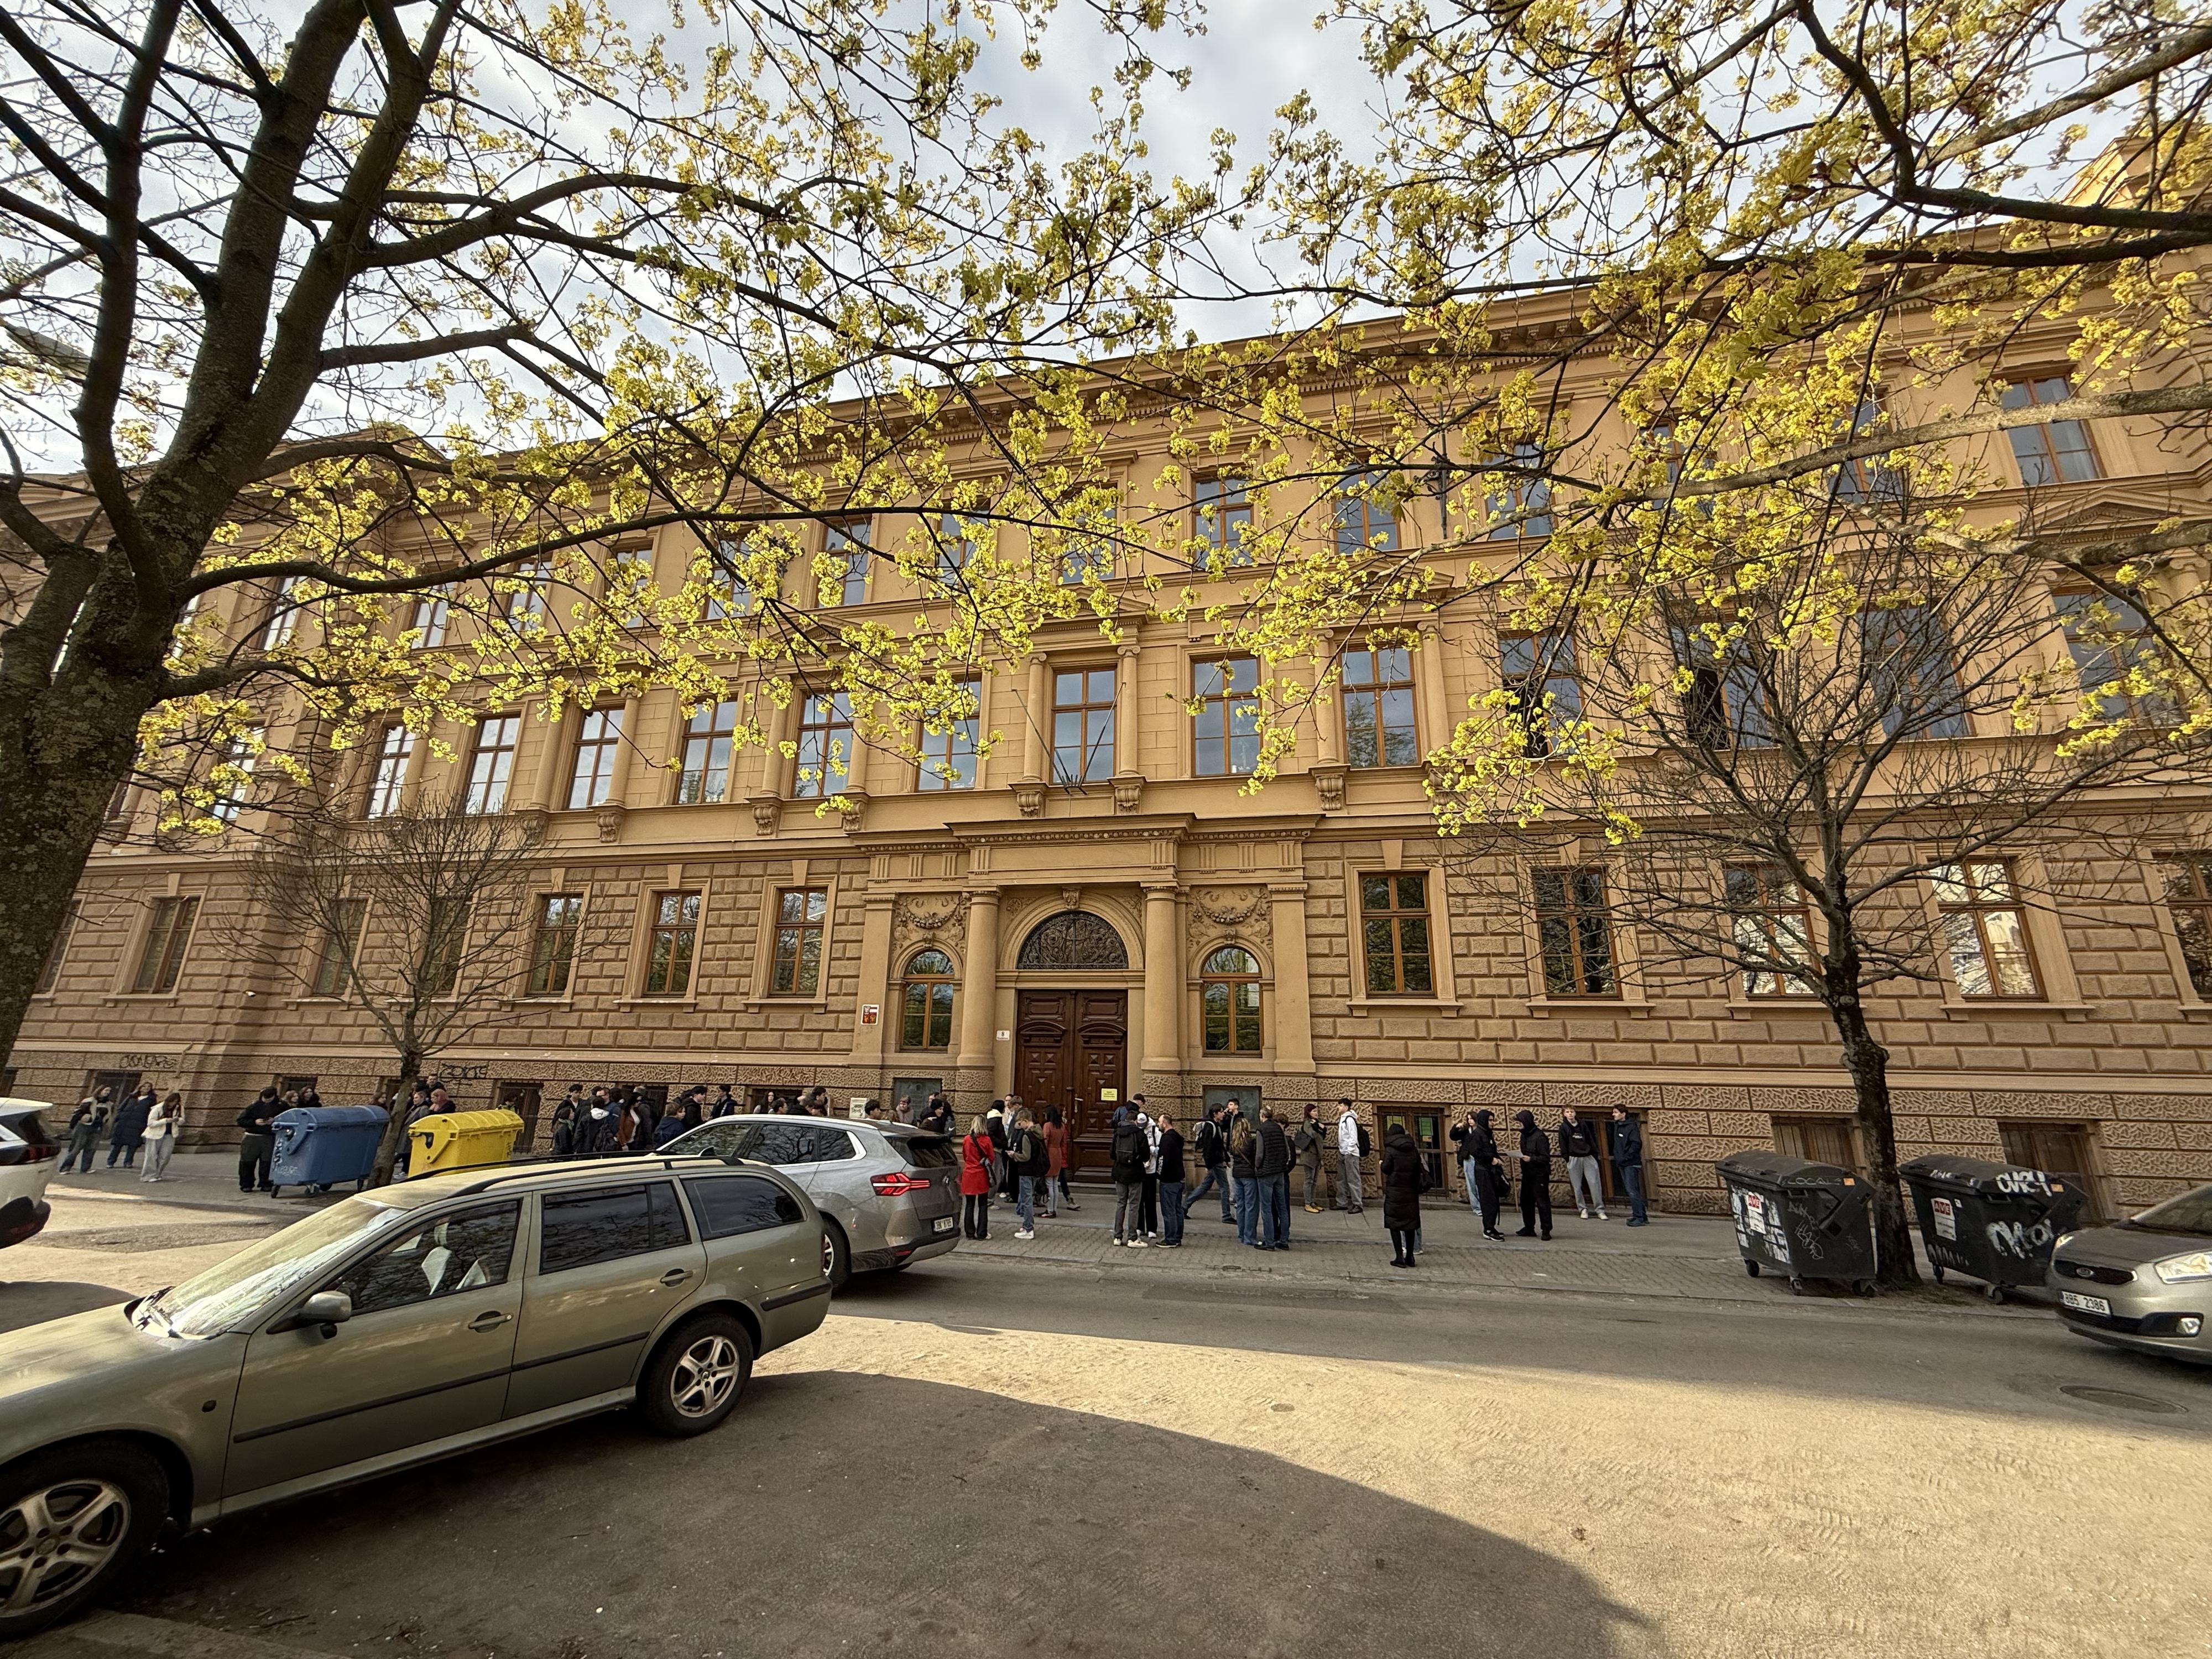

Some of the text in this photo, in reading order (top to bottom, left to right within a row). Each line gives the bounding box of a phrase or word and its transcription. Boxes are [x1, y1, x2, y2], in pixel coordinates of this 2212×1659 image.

[1748, 1194, 1761, 1209] AVE
[1934, 1201, 1950, 1215] AVE
[2083, 1297, 2105, 1311] 2386
